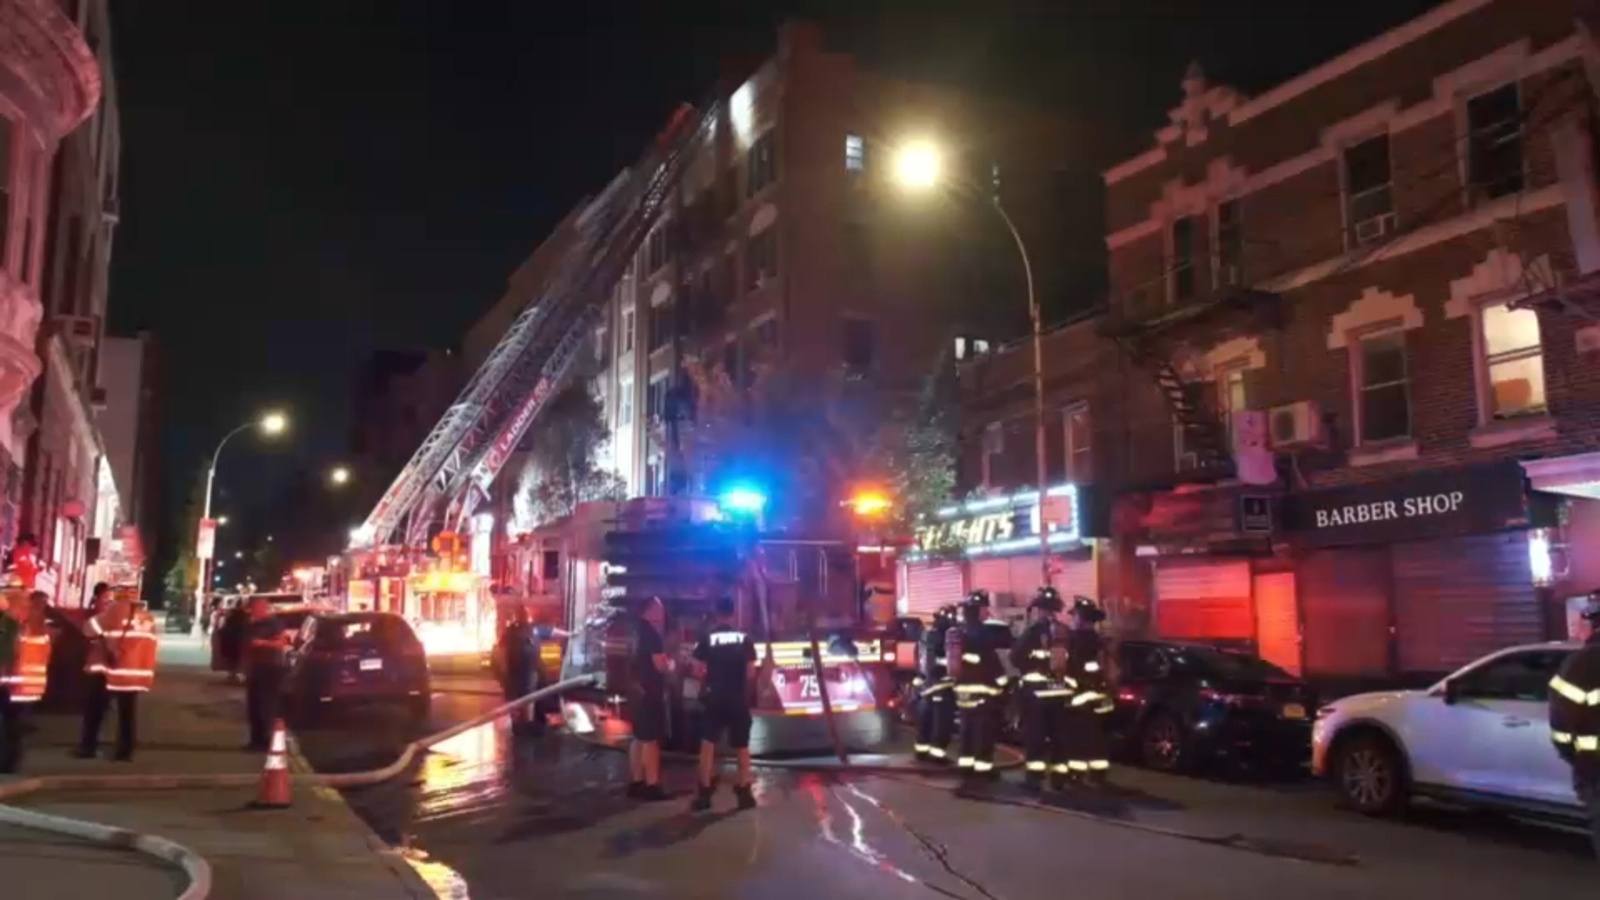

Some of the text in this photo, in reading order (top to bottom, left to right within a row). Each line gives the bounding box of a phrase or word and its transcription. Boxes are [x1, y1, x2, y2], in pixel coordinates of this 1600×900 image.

[501, 398, 536, 451] LADDER
[1315, 490, 1464, 528] BARBER SHOP
